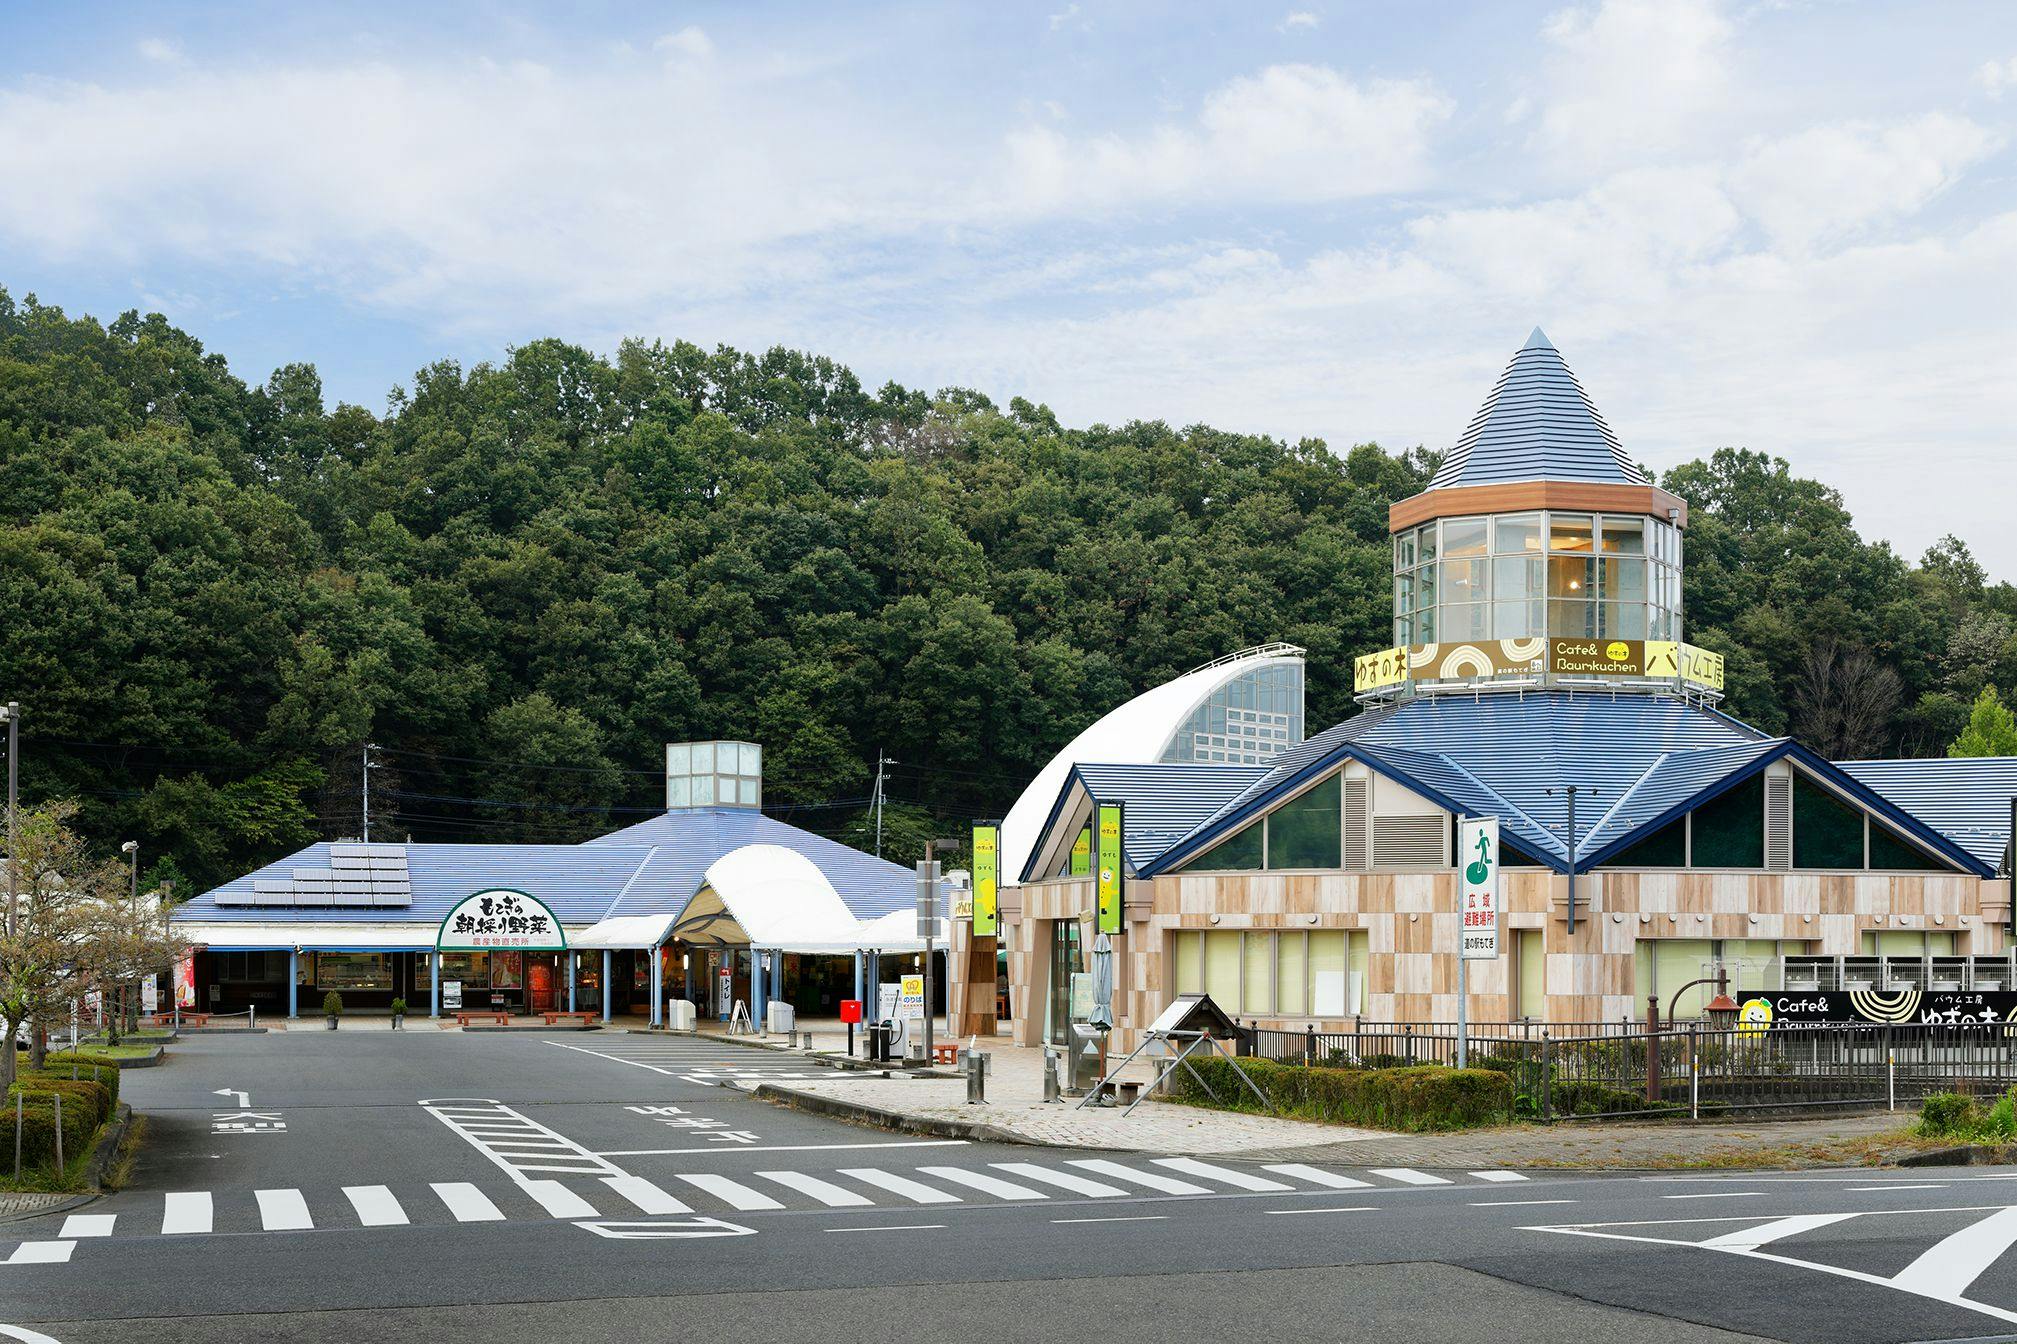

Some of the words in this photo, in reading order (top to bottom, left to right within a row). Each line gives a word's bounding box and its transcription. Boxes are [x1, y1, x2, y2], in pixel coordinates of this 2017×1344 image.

[1557, 642, 1598, 656] Cafe&
[1355, 648, 1407, 688] ゆずの木
[1557, 658, 1637, 673] Baumkuchen
[480, 896, 523, 916] もてぎの
[452, 913, 551, 935] 朝採り野菜
[1464, 911, 1494, 926] 避難場所
[472, 938, 529, 946] 農産物直売所
[1464, 937, 1494, 950] 道の駅もてぎ
[903, 996, 922, 1004] のりば
[1777, 997, 1829, 1012] Cafe&
[1934, 995, 1983, 1005] バウム工房
[1921, 1005, 1999, 1034] ゆずの木
